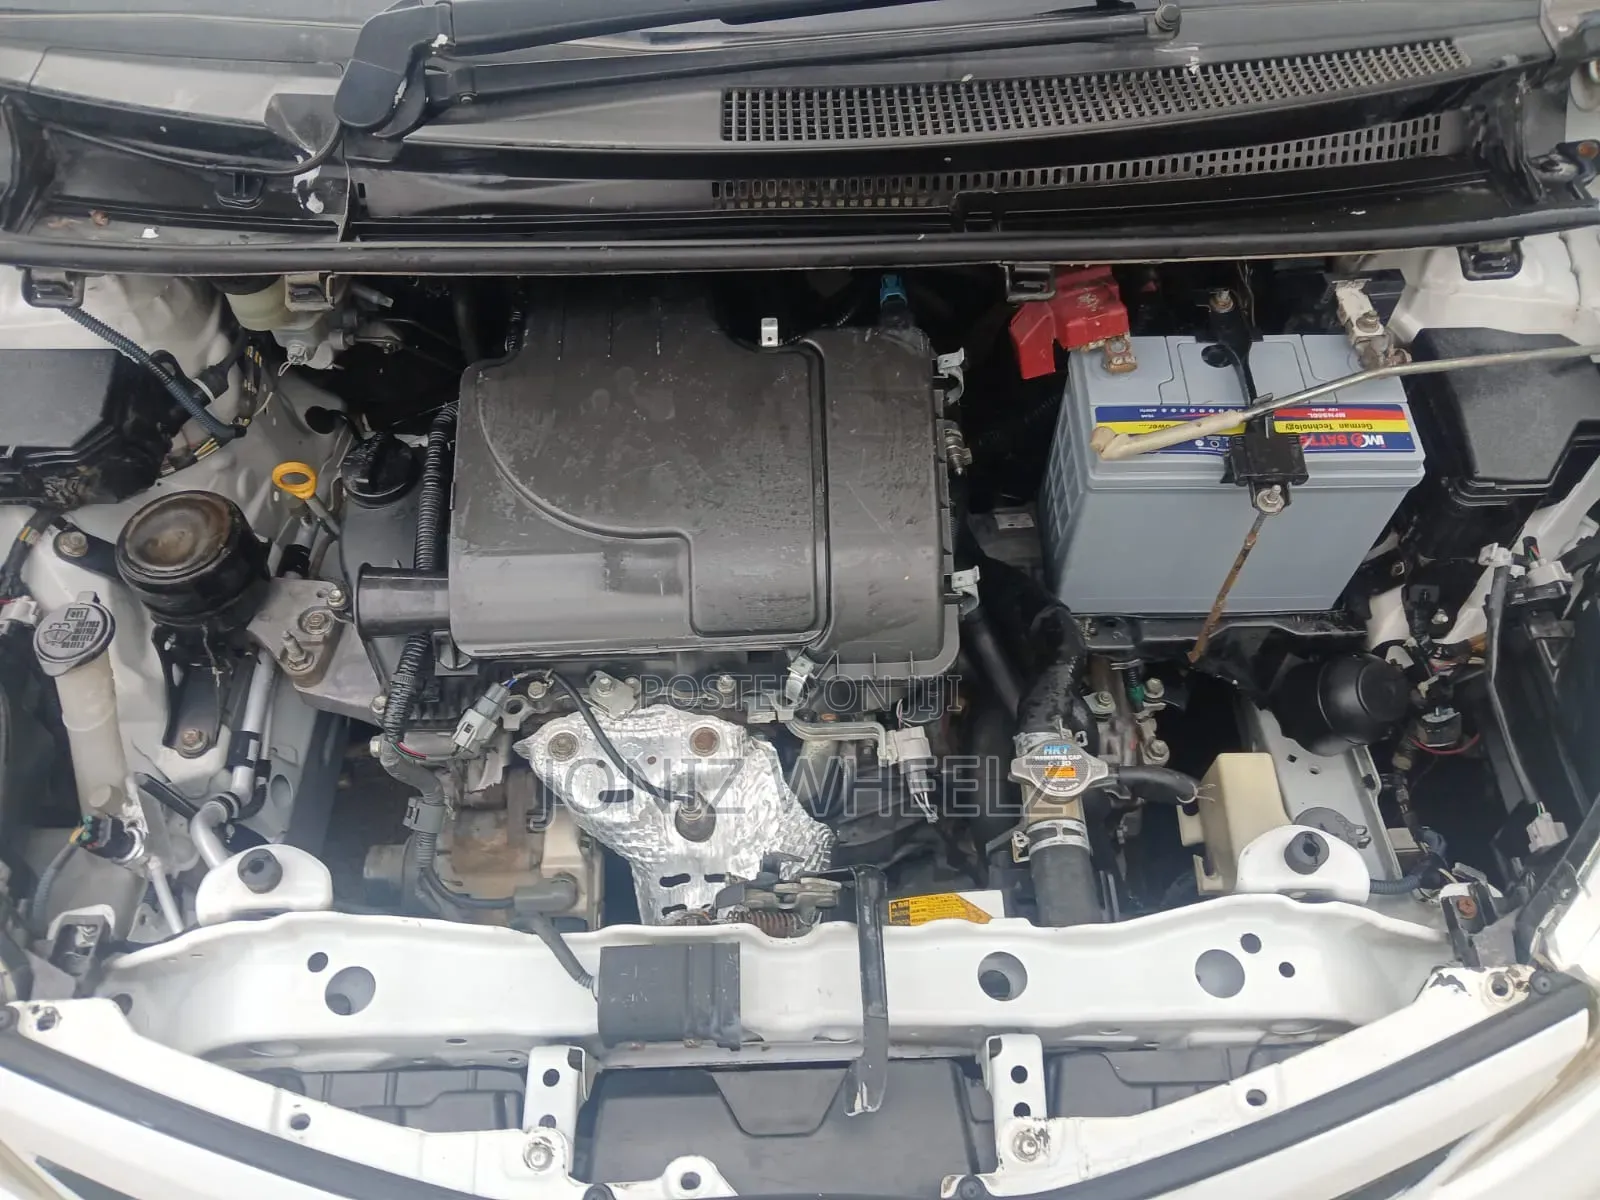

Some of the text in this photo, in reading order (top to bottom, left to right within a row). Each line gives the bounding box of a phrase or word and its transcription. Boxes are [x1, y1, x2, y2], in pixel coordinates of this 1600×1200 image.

[1285, 423, 1334, 431] Technology
[1299, 434, 1349, 446] BATTE
[1043, 744, 1071, 755] HKT
